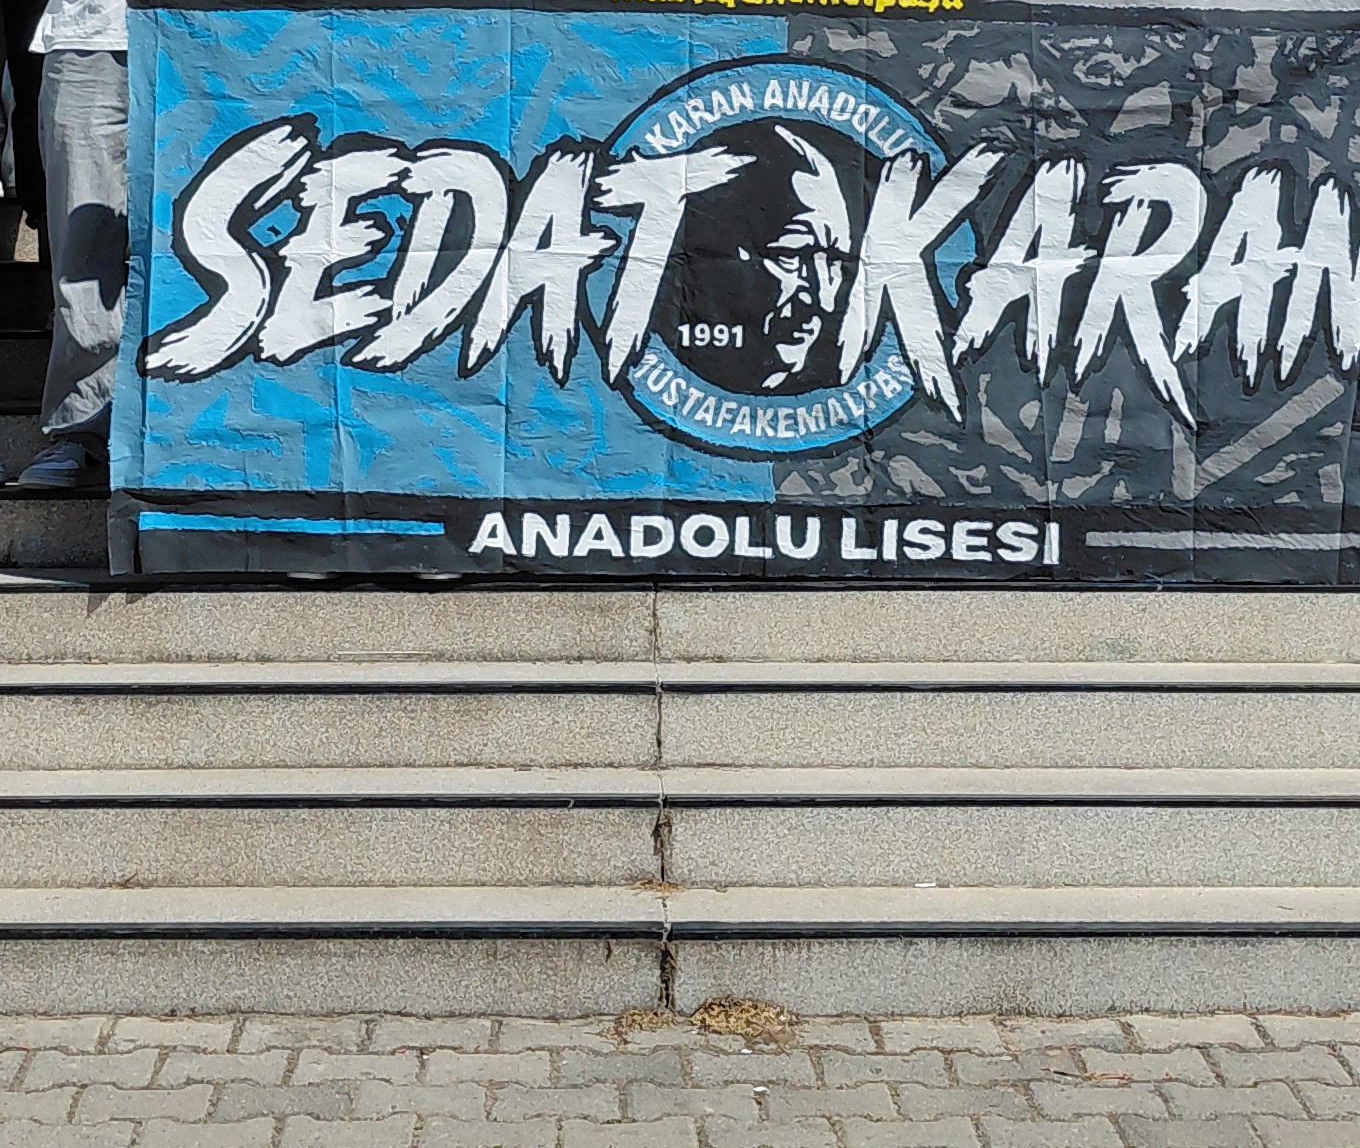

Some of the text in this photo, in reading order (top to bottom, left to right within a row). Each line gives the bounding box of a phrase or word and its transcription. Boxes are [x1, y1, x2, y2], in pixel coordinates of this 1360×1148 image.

[644, 78, 916, 157] KARAN ANADOLU
[143, 122, 758, 384] SEDAT
[678, 323, 745, 348] 1991
[467, 511, 1061, 566] ANADOLU LISESI
